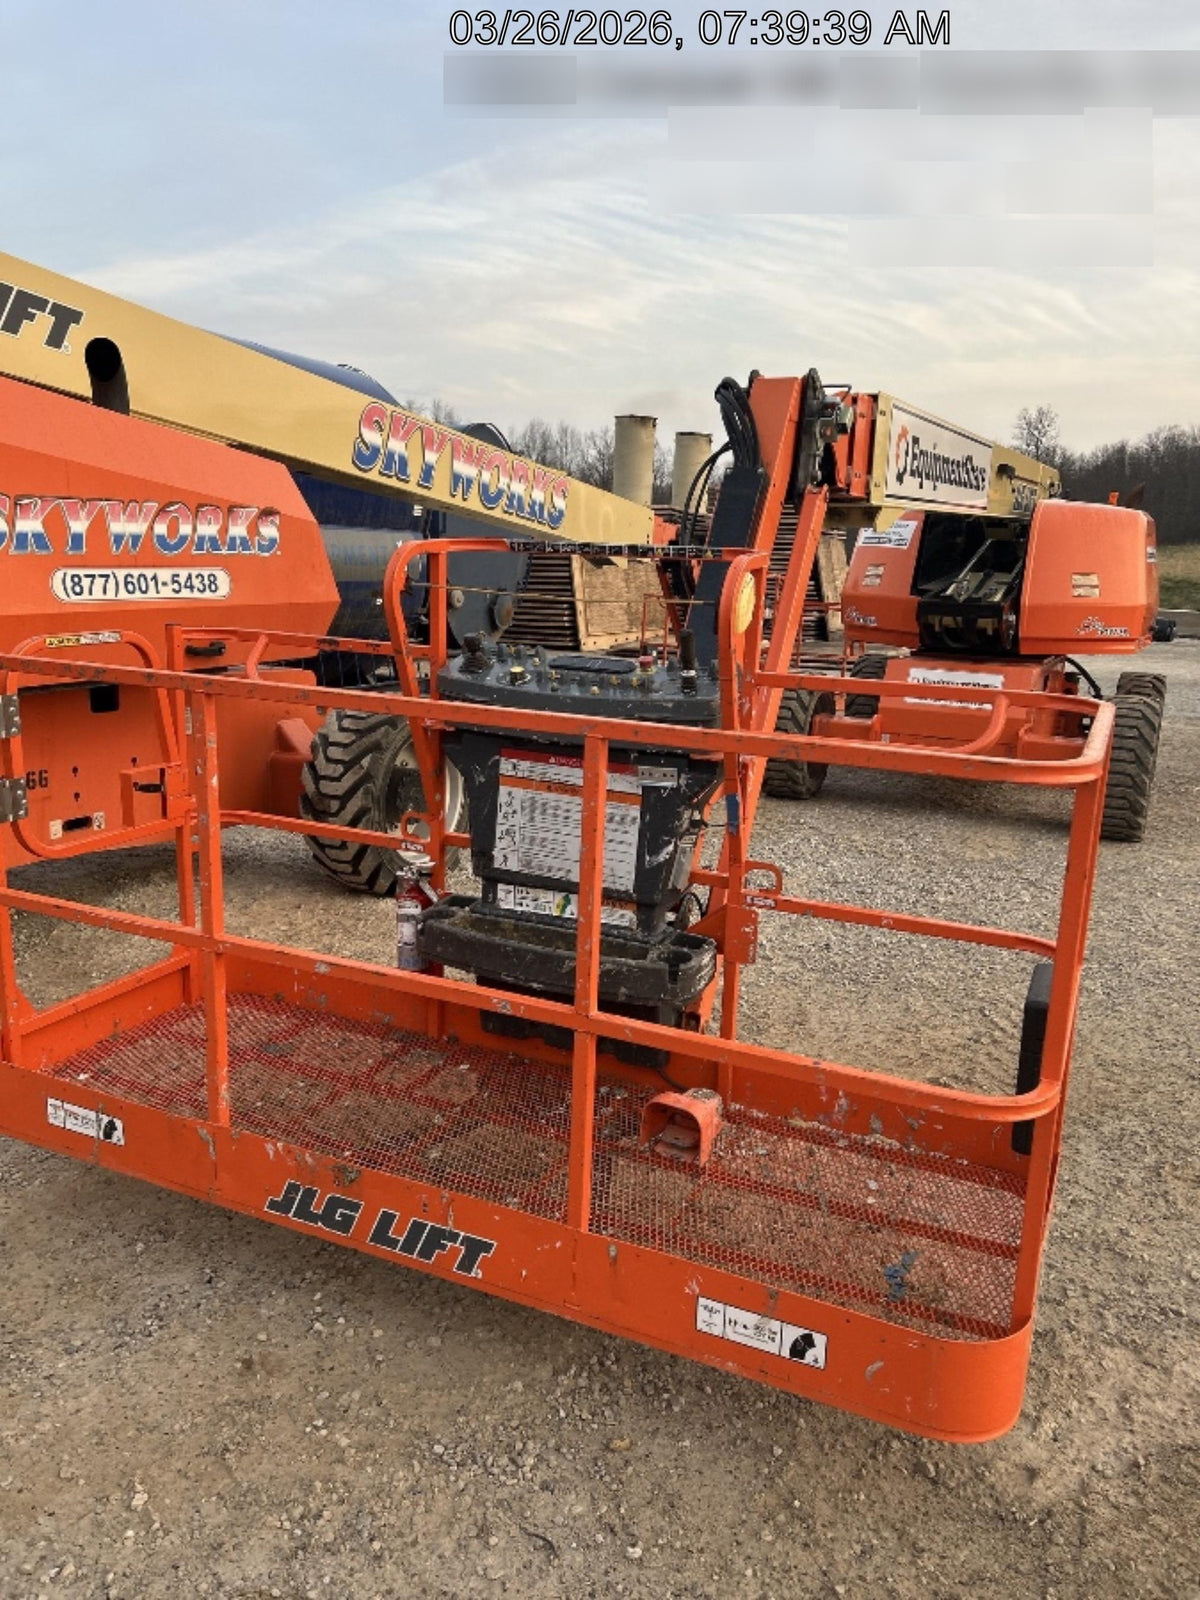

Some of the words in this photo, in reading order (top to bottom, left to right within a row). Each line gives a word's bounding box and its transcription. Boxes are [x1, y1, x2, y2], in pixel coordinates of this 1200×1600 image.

[352, 401, 570, 529] SKYWORKS
[264, 1179, 364, 1237] JLG
[366, 1208, 498, 1279] LIFT
